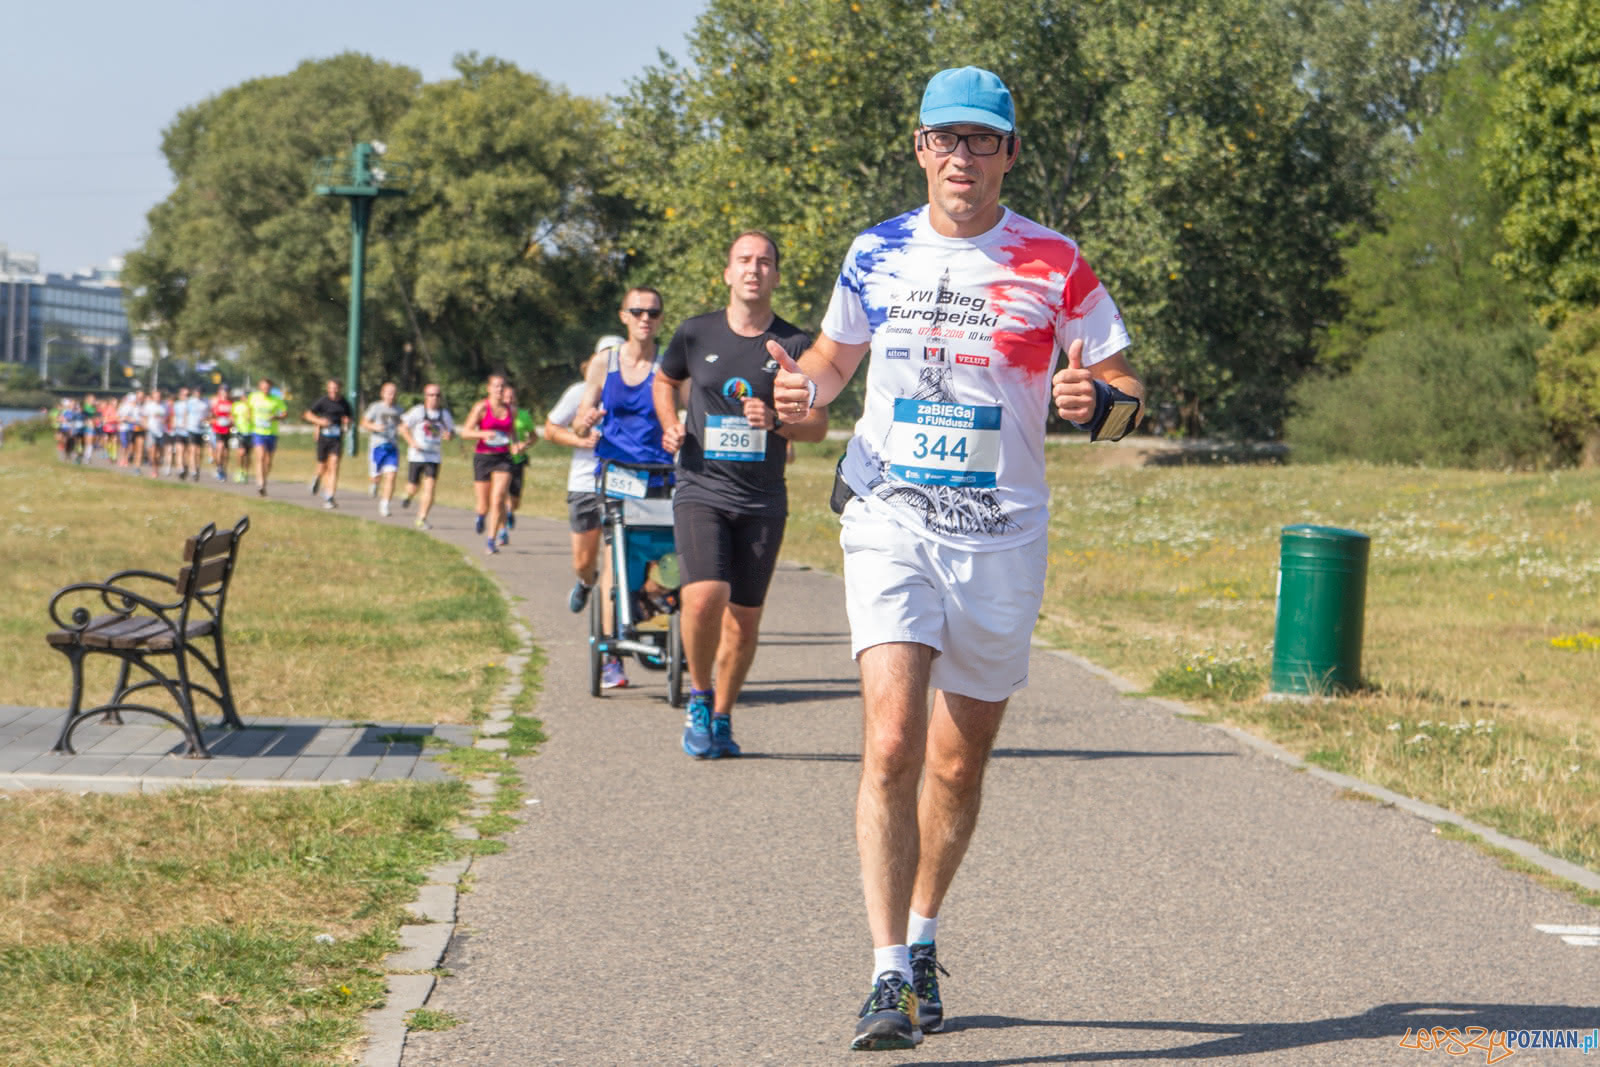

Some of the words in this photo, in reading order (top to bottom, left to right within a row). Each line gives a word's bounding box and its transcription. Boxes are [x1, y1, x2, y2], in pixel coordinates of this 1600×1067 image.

[907, 290, 934, 303] XVI
[937, 291, 986, 311] Bieg
[888, 305, 1000, 327] Europejski
[968, 331, 978, 340] 10
[979, 333, 993, 342] km
[958, 355, 987, 366] VELUX
[918, 405, 975, 421] zaBIEGaj
[925, 417, 974, 429] FUNdusze
[720, 433, 750, 447] 296
[913, 433, 968, 463] 344
[610, 478, 633, 491] 551
